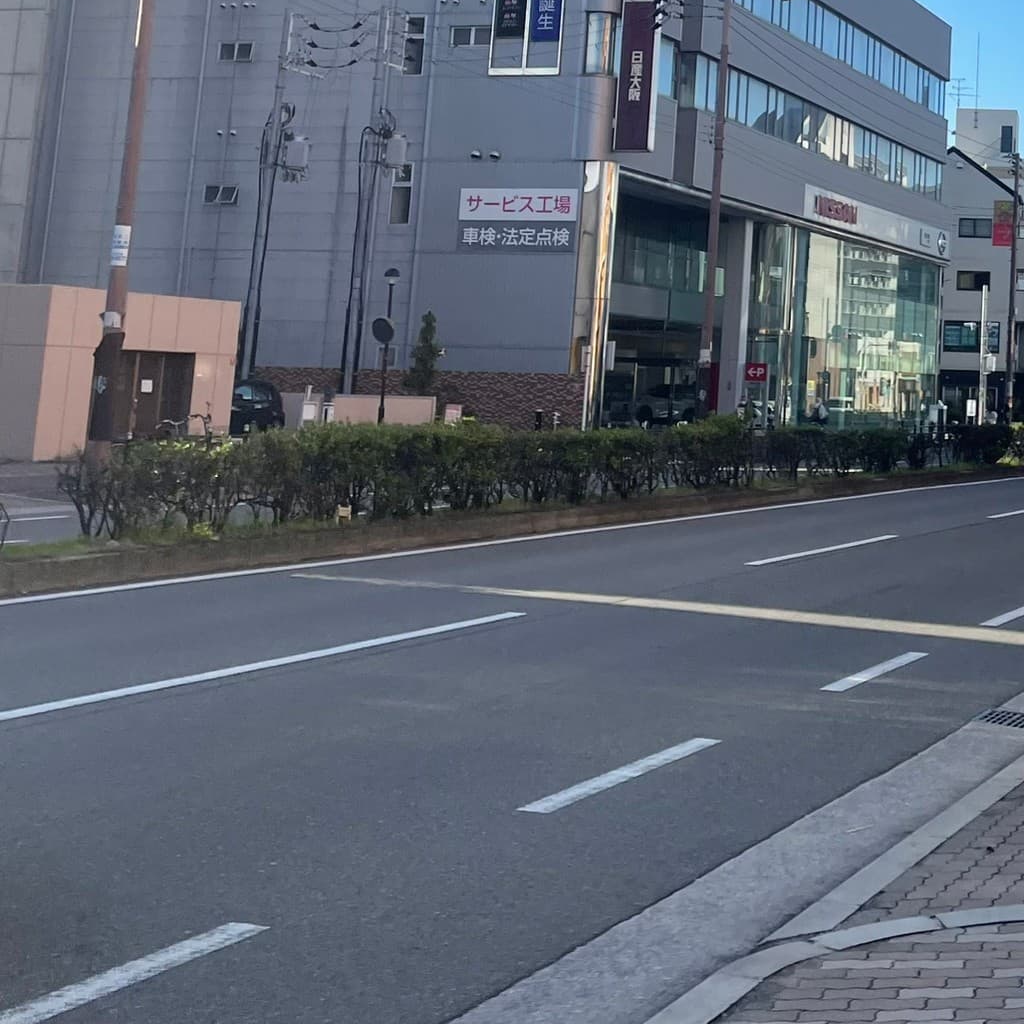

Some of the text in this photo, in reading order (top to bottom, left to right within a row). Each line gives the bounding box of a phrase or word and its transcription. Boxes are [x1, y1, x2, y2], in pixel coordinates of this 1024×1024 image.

[628, 50, 644, 102] 日産大阪
[466, 195, 571, 214] サービス工場
[815, 195, 858, 225] NISSAN
[756, 367, 765, 377] P
